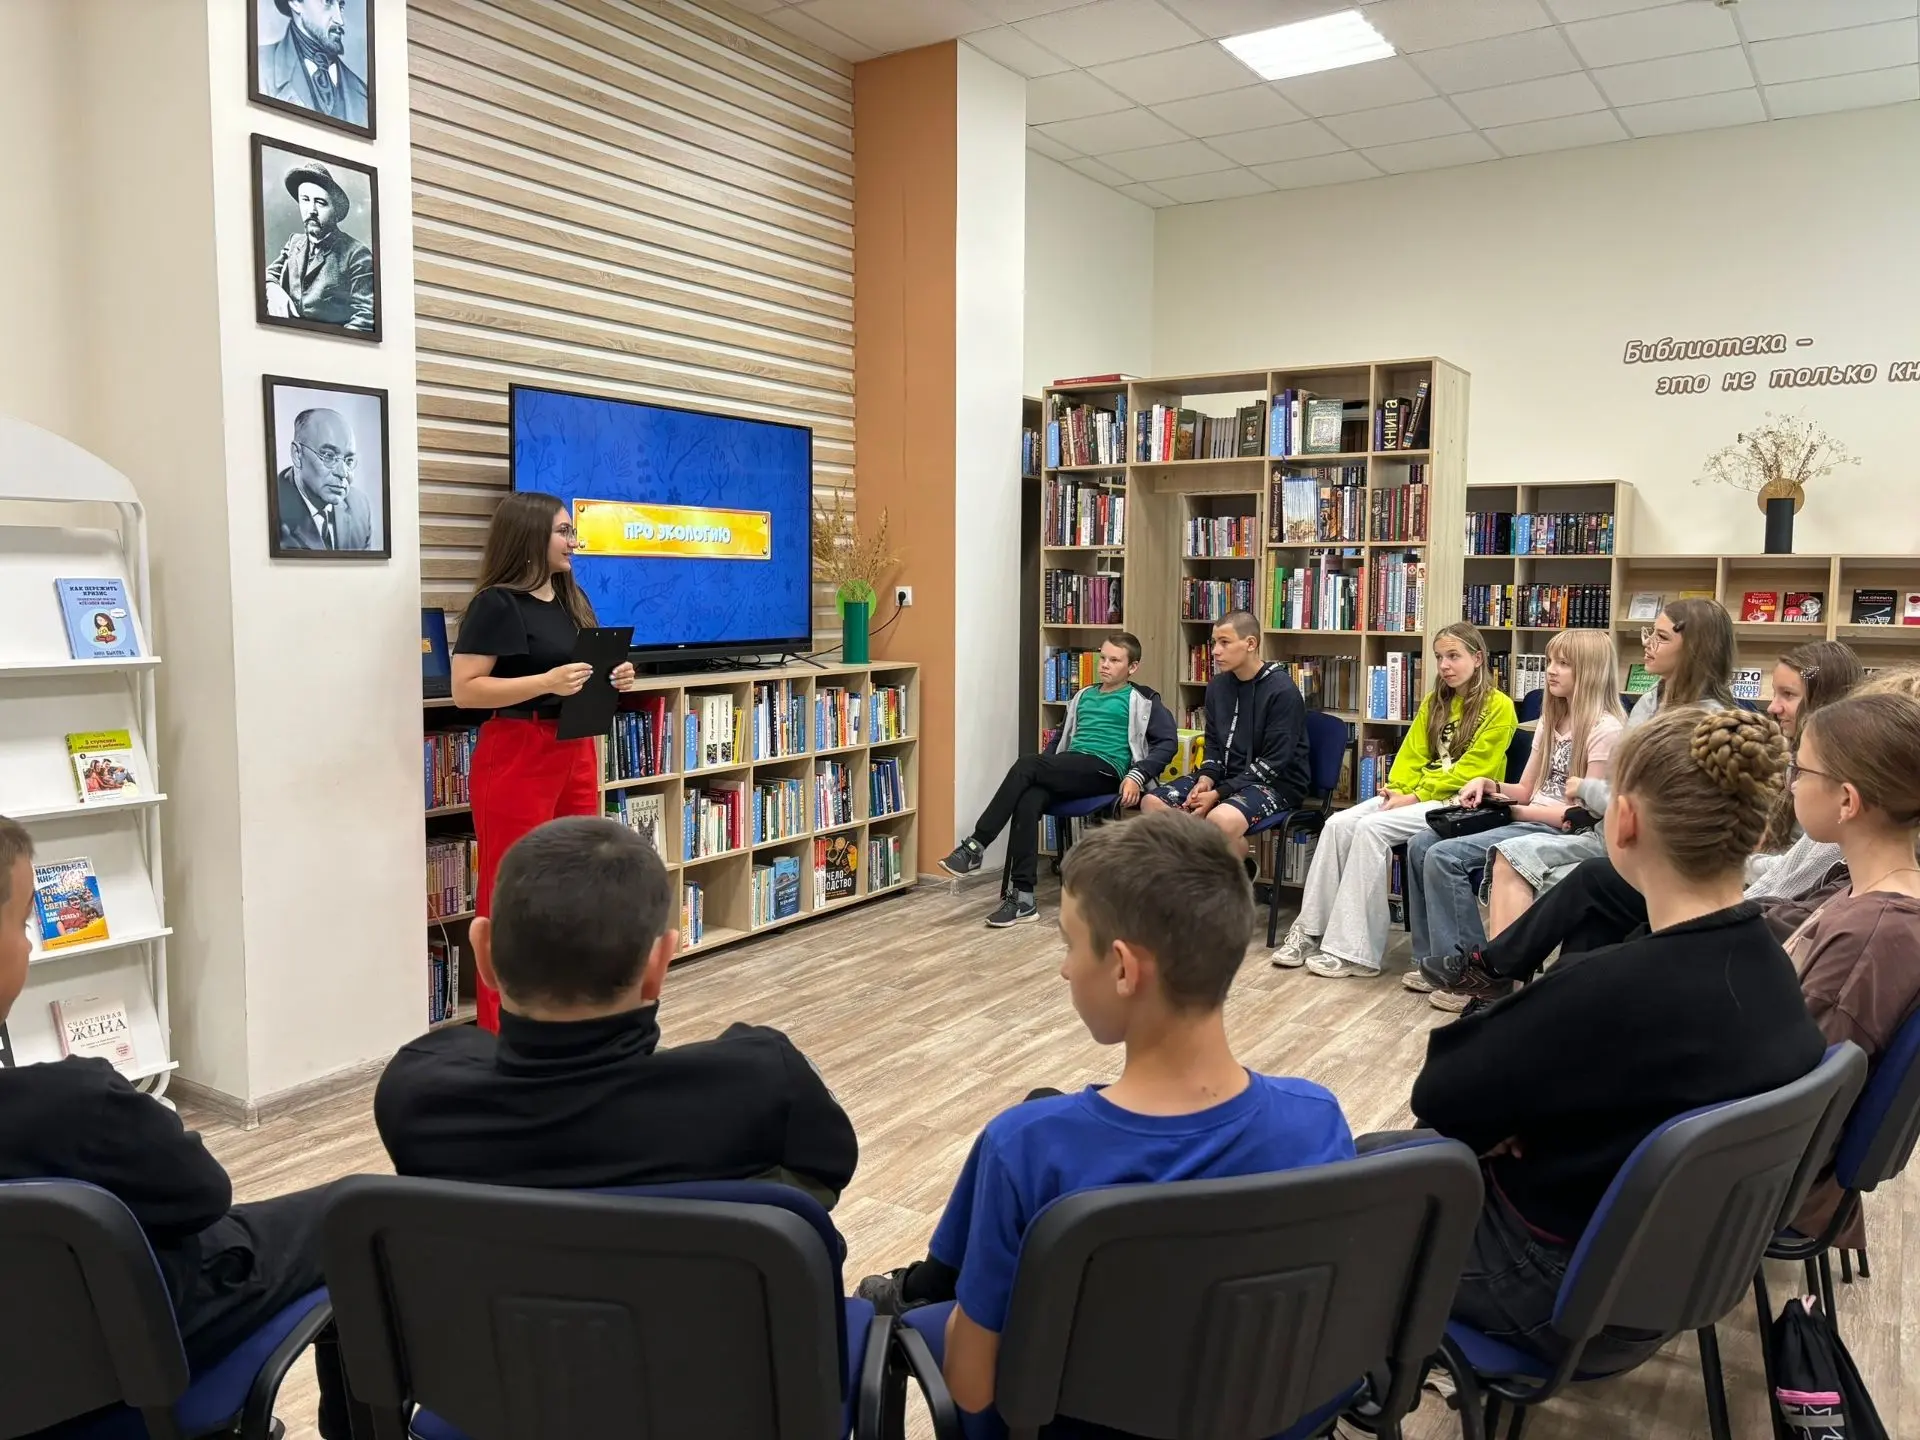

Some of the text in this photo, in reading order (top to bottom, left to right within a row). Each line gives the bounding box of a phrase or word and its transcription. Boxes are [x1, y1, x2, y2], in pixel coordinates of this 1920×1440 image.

[1624, 334, 1786, 363] Библиотека
[1656, 373, 1710, 394] это
[1722, 371, 1756, 391] не
[1769, 364, 1877, 388] только
[623, 522, 731, 544] ПРО ЭКОЛОГИЮ
[632, 813, 659, 824] СОБАК
[35, 862, 88, 875] НАСТОЛЬНАЯ
[826, 870, 847, 880] ЧЕЛО-
[826, 877, 852, 891] ОДСТВО
[43, 901, 68, 911] СВЕТЕ
[67, 1011, 122, 1029] СЧАСТЛИВАЯ
[70, 1018, 127, 1042] ЖЕНА
